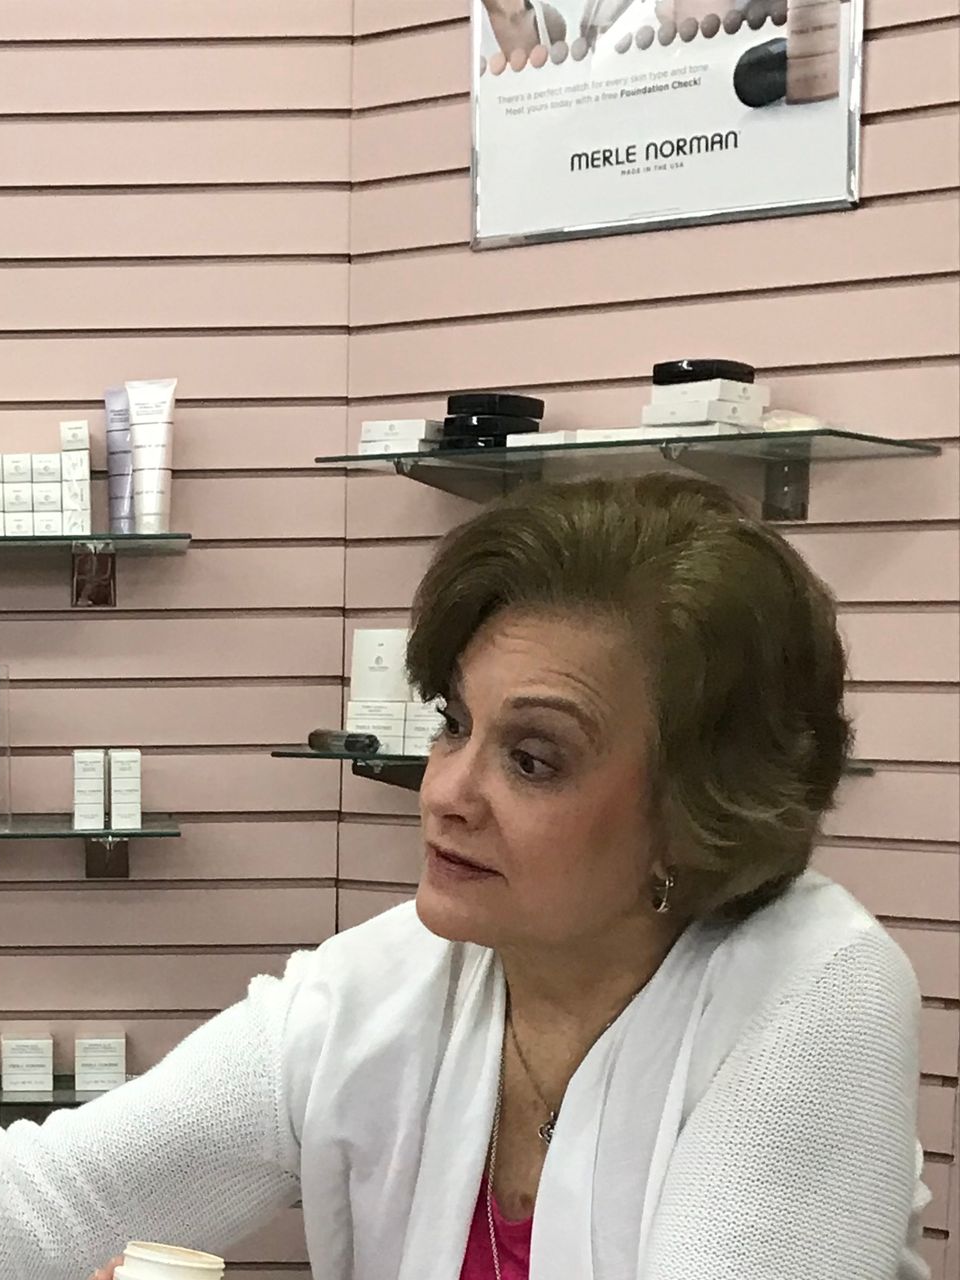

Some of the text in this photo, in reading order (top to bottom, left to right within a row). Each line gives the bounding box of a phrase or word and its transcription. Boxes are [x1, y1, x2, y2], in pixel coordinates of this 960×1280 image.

[620, 83, 670, 98] Foundation
[570, 130, 738, 172] MERLE NORMAN
[621, 168, 640, 176] MADE
